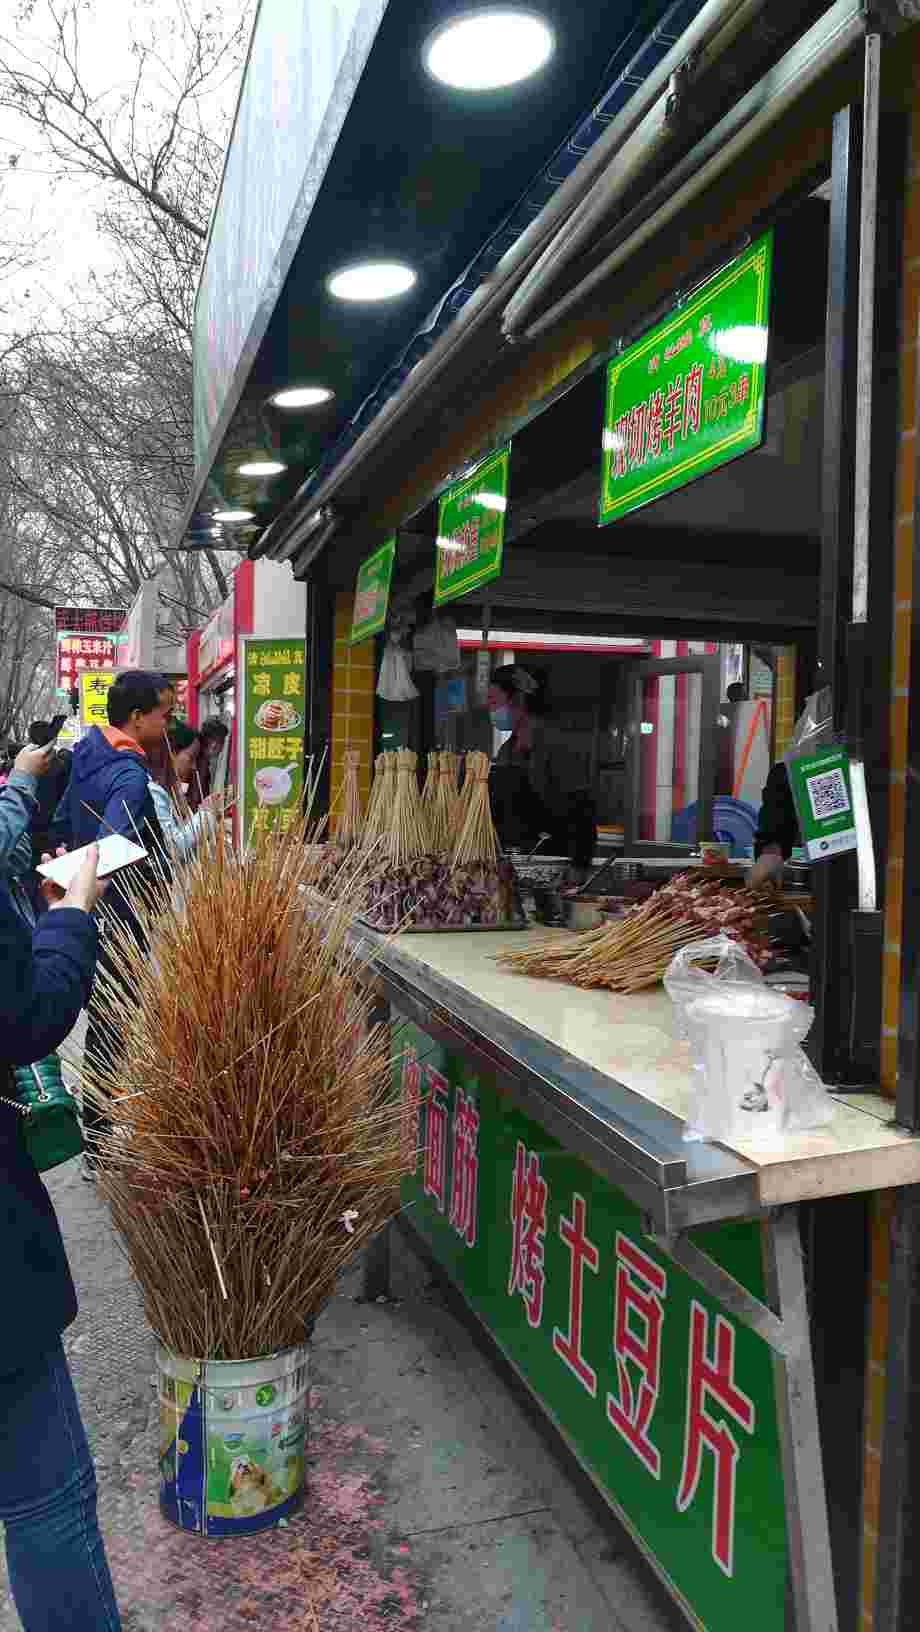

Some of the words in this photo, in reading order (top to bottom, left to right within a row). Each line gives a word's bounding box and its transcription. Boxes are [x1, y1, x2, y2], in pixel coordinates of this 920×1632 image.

[85, 677, 110, 719] 寿司
[508, 1142, 755, 1577] 烤土豆片
